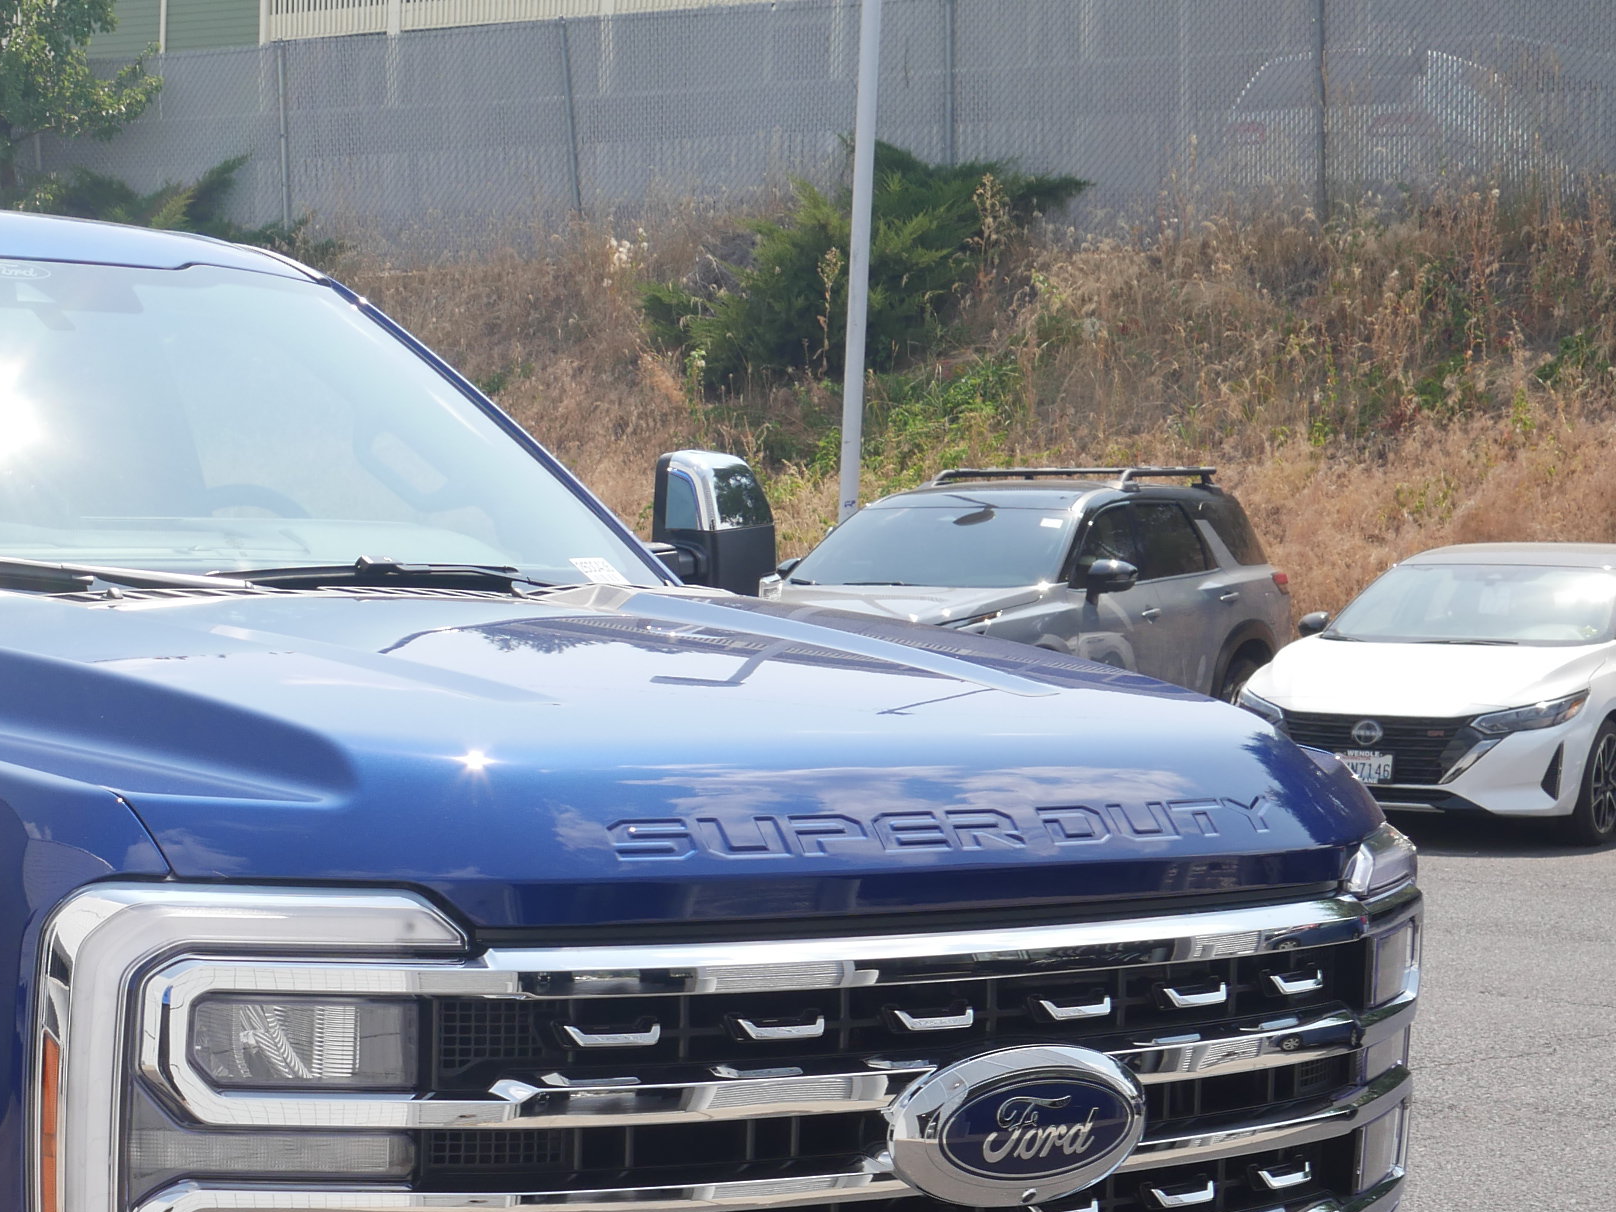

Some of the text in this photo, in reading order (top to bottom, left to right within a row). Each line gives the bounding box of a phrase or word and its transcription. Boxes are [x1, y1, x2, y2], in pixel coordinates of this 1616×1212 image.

[1347, 749, 1380, 758] WENDLE
[605, 794, 1273, 862] SUPER DUTY
[982, 1095, 1100, 1164] Ford
